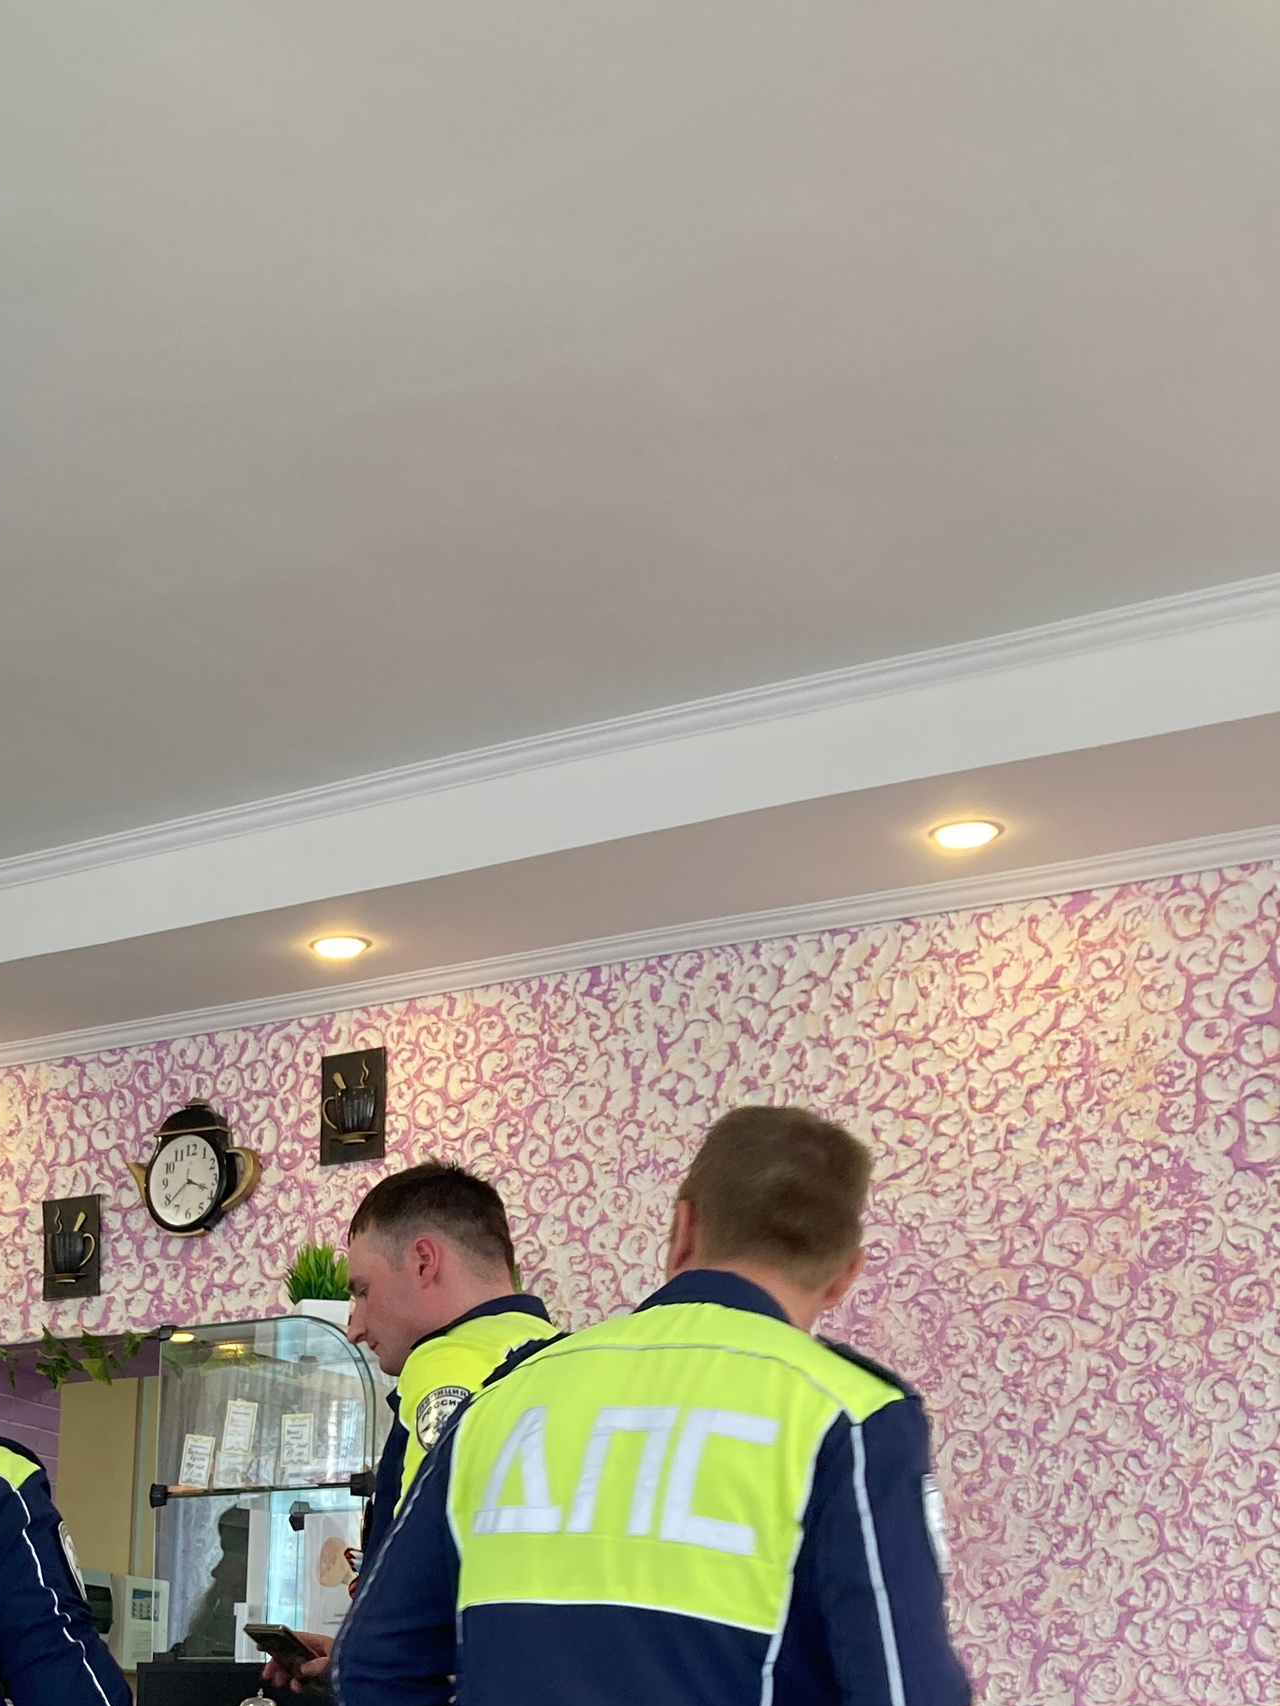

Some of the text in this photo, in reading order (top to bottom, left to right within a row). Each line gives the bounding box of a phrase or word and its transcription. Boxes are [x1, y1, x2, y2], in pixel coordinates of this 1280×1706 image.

[174, 1148, 184, 1162] 11
[186, 1143, 198, 1157] 12
[202, 1147, 207, 1160] 1
[164, 1161, 175, 1175] 10
[209, 1158, 216, 1171] 2
[162, 1178, 169, 1190] 9
[211, 1173, 218, 1186] 3
[164, 1193, 172, 1206] 8
[207, 1190, 214, 1201] 4
[174, 1204, 181, 1217] 7
[184, 1207, 192, 1220] 6
[197, 1202, 204, 1215] 5
[421, 1399, 457, 1423] РОССИ
[473, 1406, 781, 1557] ДПС
